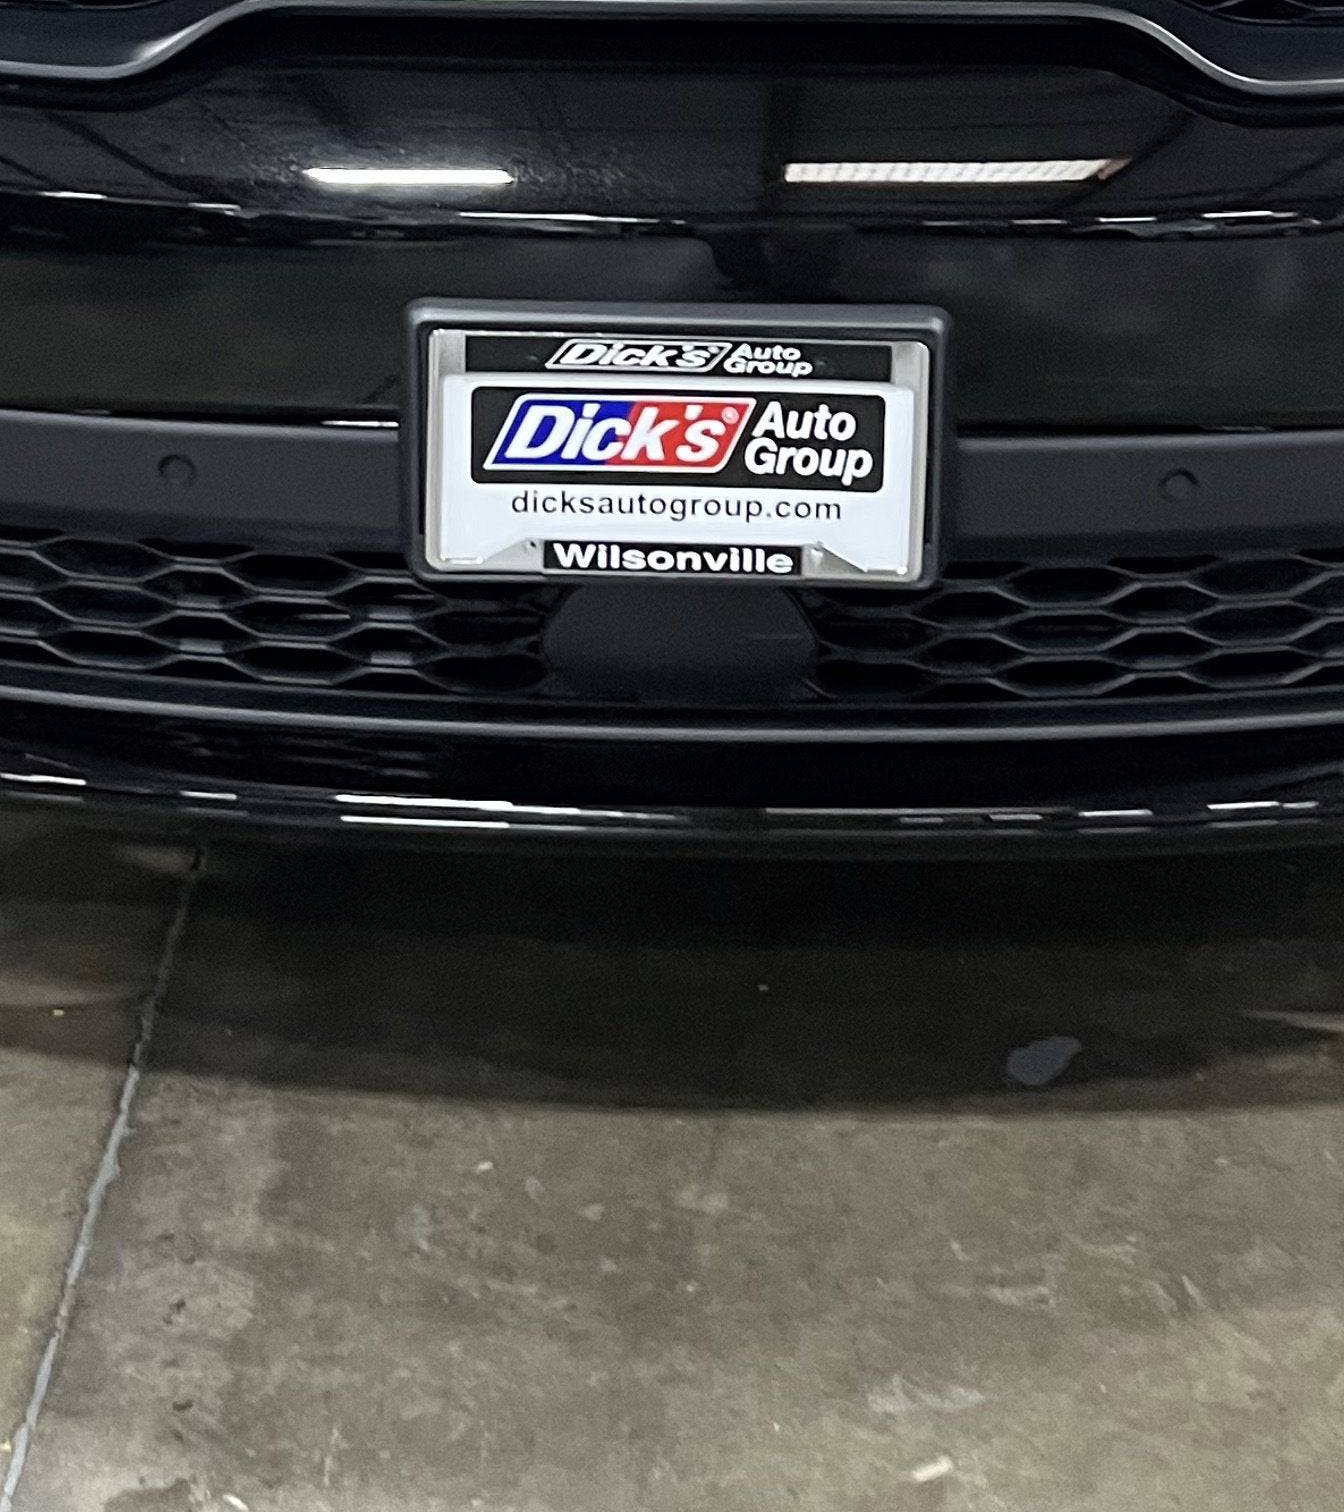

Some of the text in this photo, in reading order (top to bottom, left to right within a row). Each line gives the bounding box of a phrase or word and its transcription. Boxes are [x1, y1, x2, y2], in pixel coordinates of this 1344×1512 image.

[559, 342, 801, 368] Dick's Auto
[723, 358, 813, 377] Group
[504, 401, 856, 462] Dick's Auto
[744, 437, 874, 486] Group
[511, 490, 842, 522] dicksautogroup.com
[552, 542, 794, 574] Wilsonville
